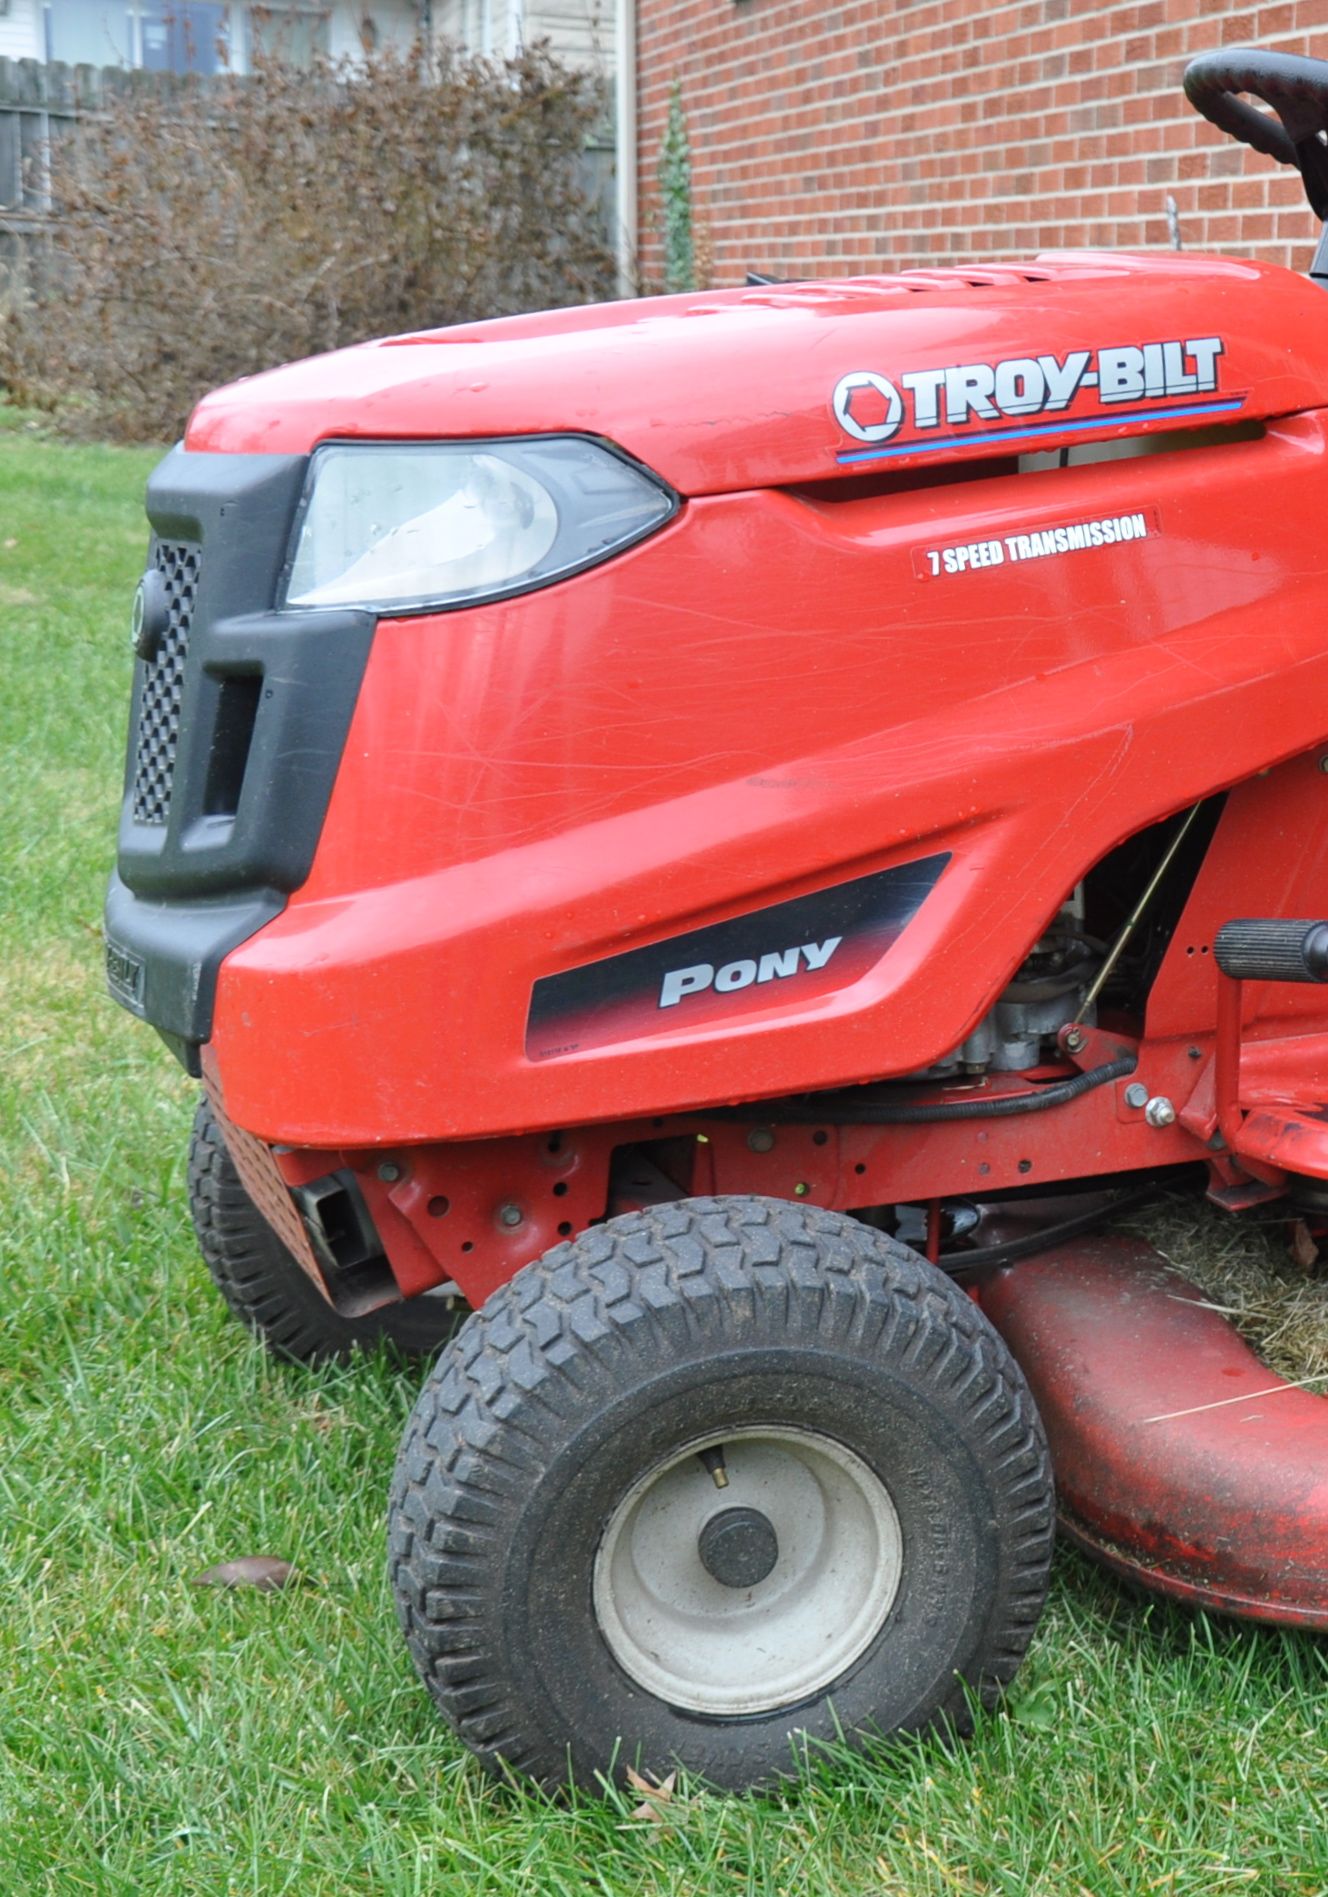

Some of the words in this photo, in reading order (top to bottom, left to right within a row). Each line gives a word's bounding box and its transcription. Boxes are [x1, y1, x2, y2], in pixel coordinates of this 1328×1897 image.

[902, 337, 1224, 428] TROY-BILT
[927, 552, 940, 576] 7
[943, 537, 1004, 574] SPEED
[1004, 513, 1147, 562] TRANSMISSION
